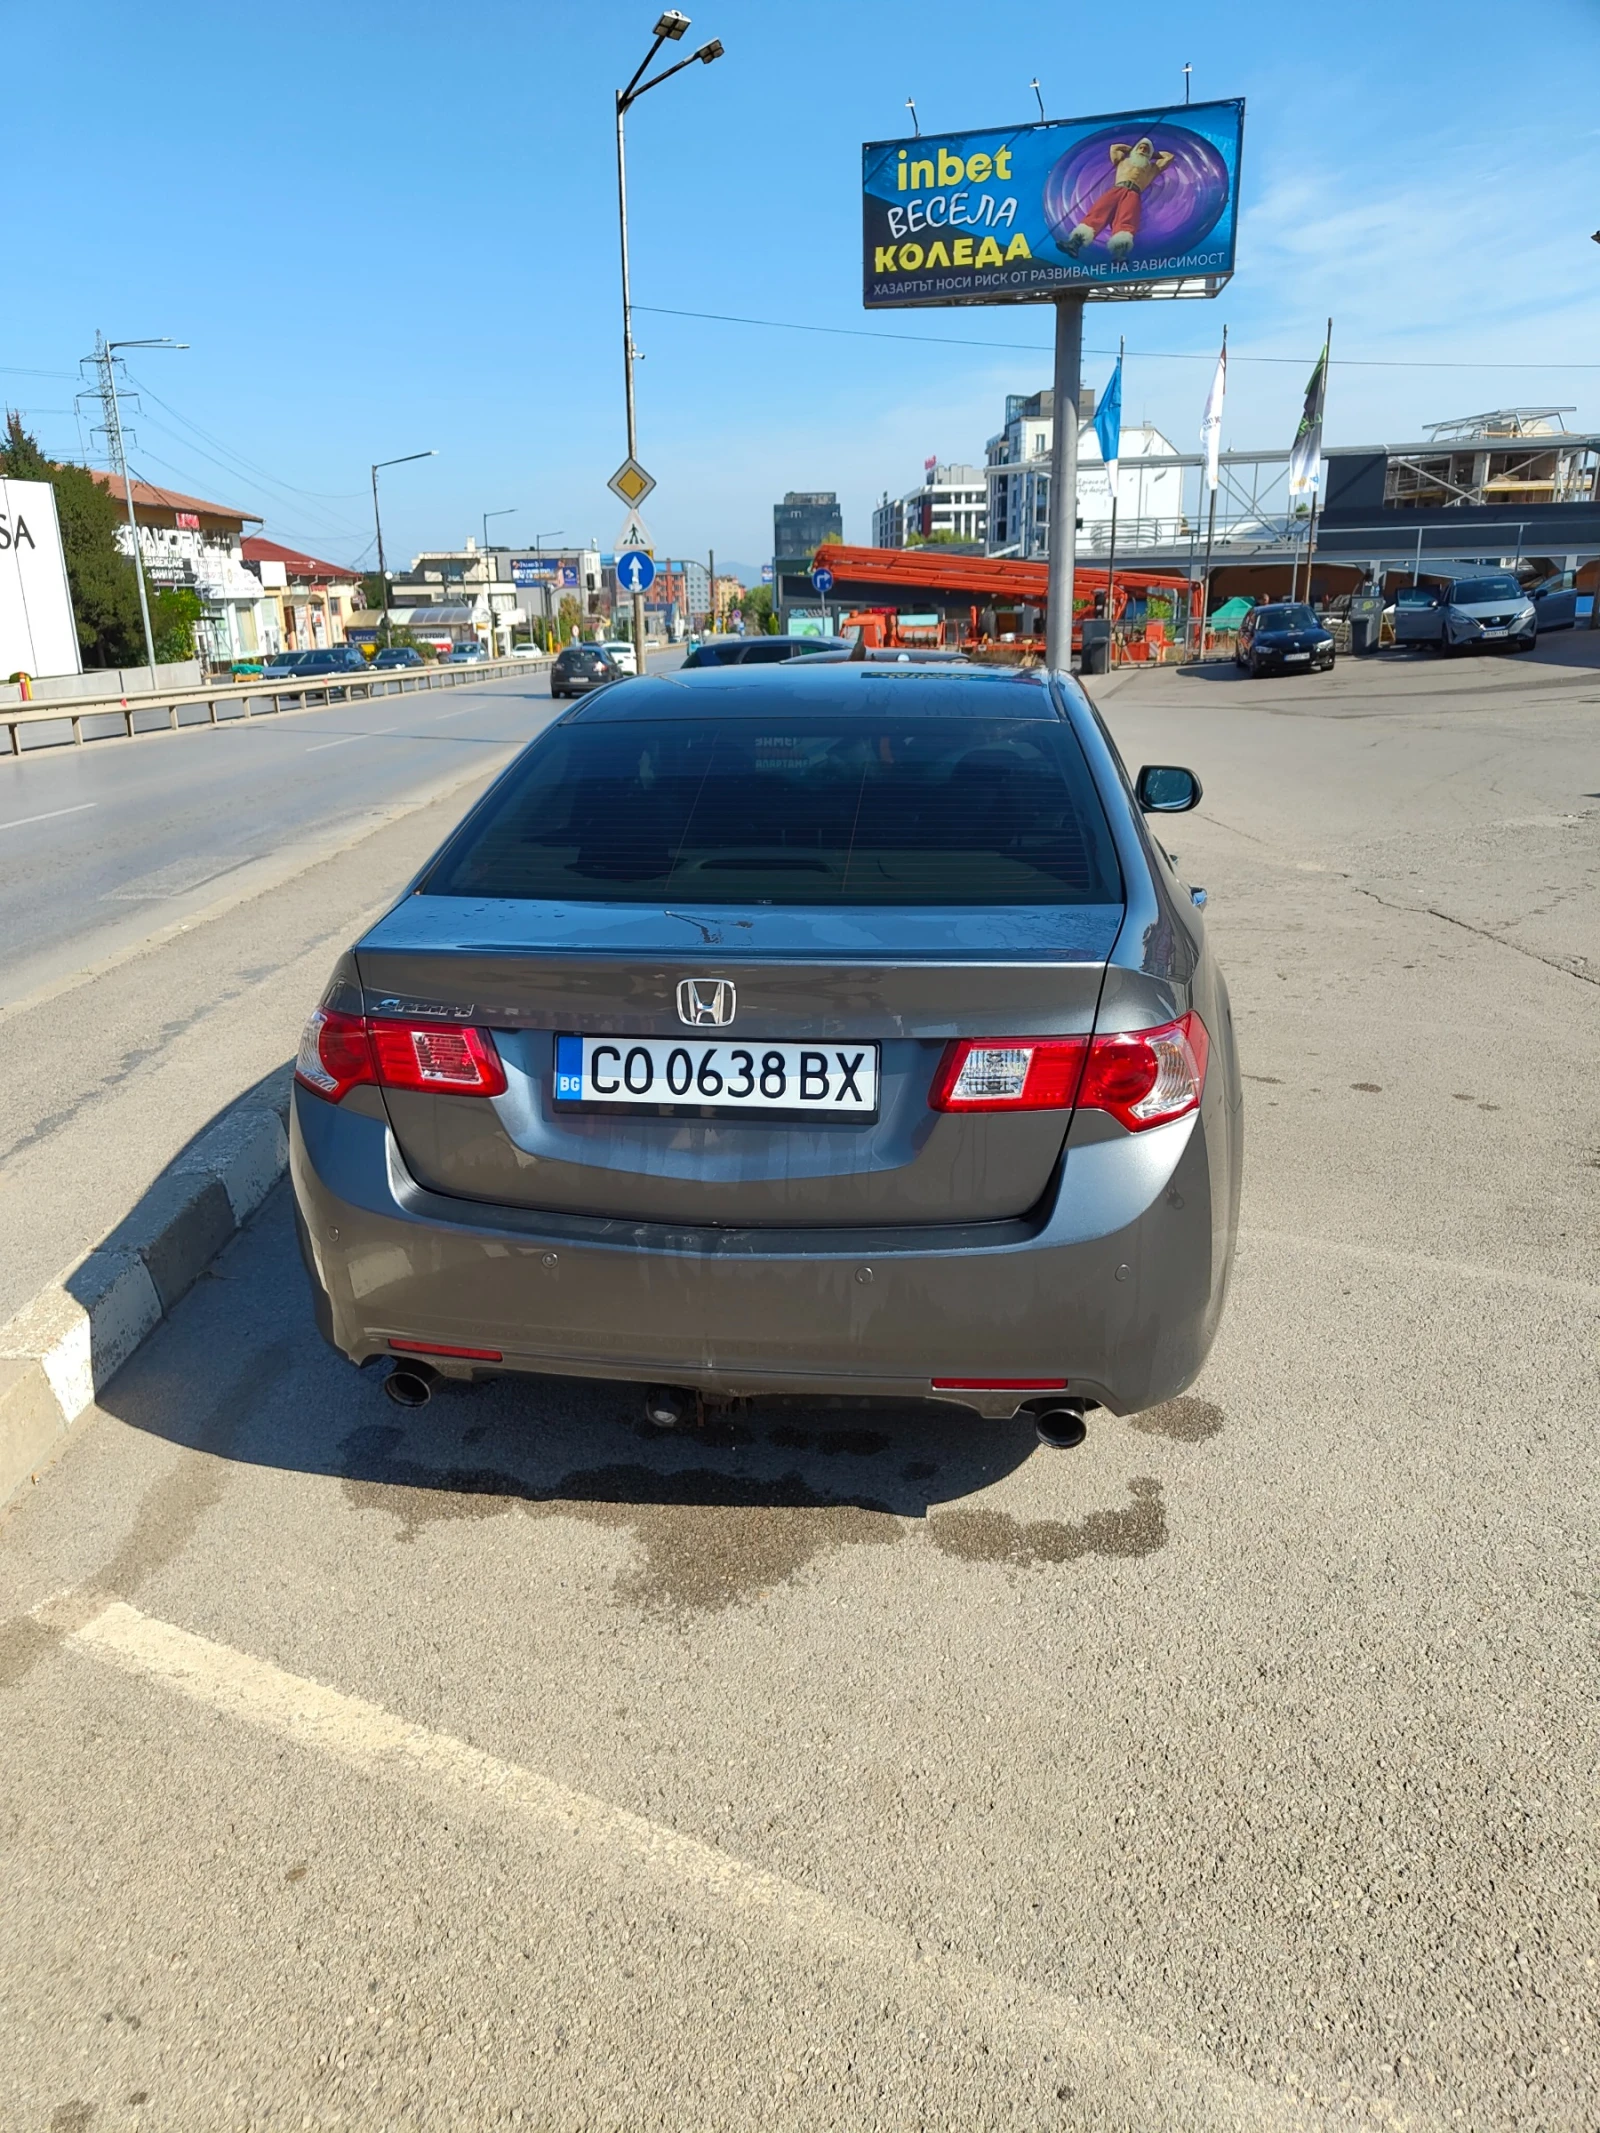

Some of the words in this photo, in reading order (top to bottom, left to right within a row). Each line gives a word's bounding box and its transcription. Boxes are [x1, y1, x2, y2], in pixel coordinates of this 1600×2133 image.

[898, 144, 1012, 191] inbet
[887, 192, 1018, 239] ВЕСЕЛА
[874, 279, 934, 295] ХАЗАРТЪТ
[936, 276, 971, 290] НОСИ
[975, 272, 1008, 287] РИСК
[1010, 270, 1028, 283] ОТ
[1031, 263, 1107, 281] РАЗВИВАНЕ
[1110, 262, 1130, 273] НА
[1132, 252, 1225, 270] ЗАВИСИМОСТ
[875, 232, 1032, 273] КОЛЕДА
[559, 1076, 581, 1091] BG
[666, 1048, 787, 1099] 0638
[799, 1051, 866, 1102] BX
